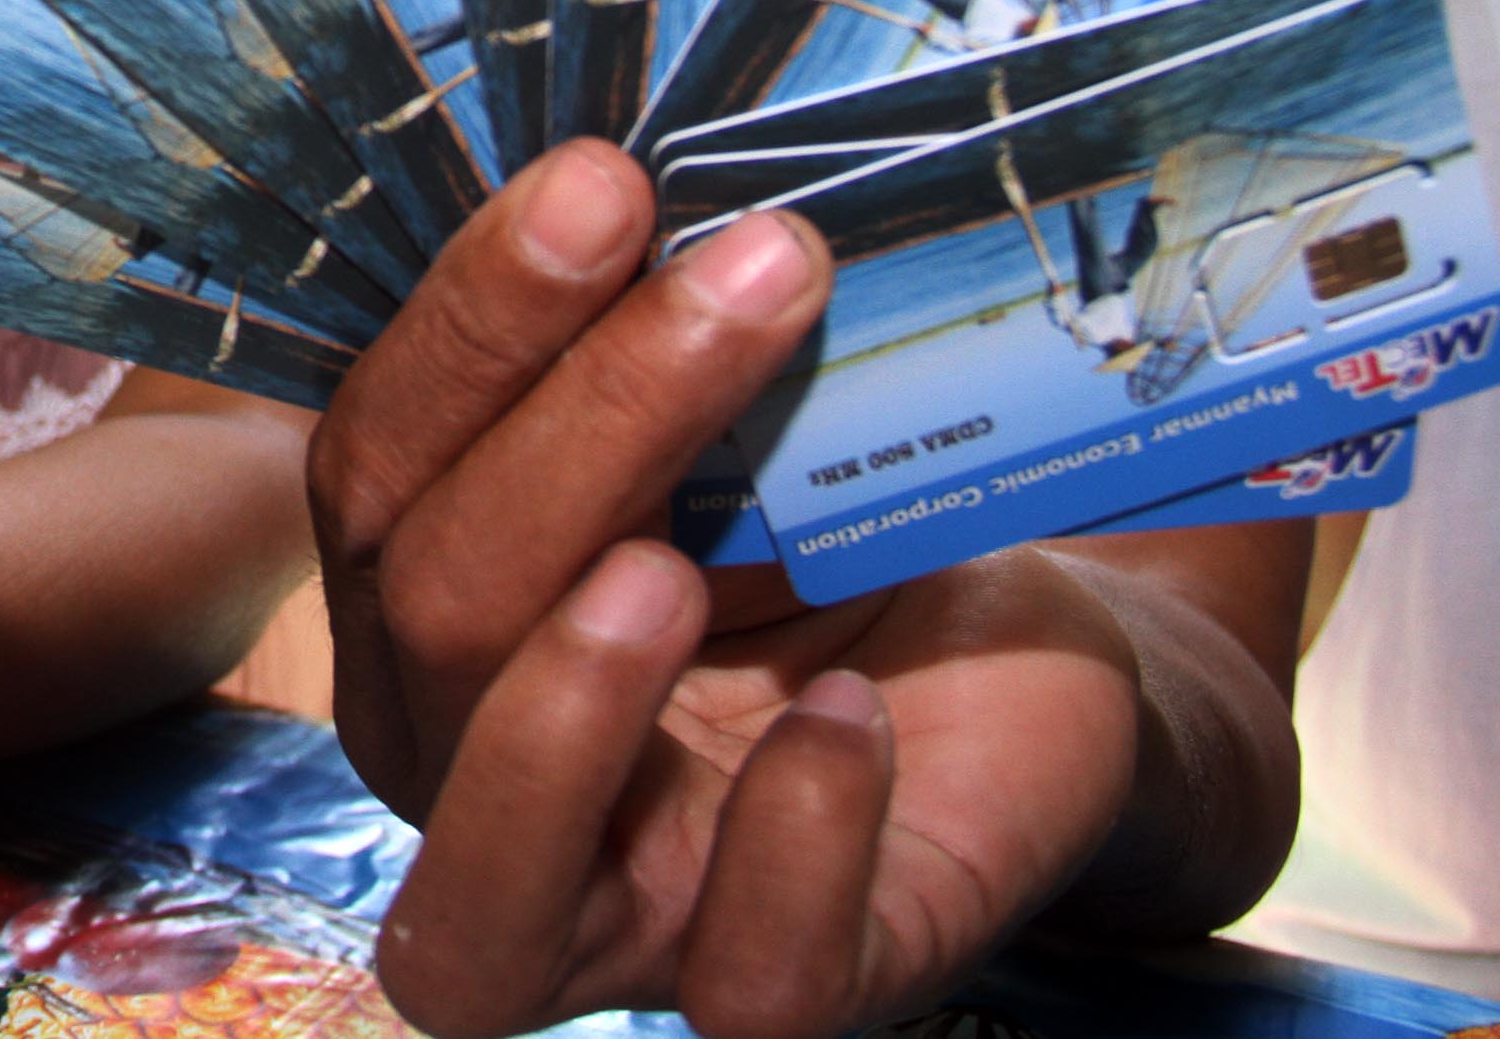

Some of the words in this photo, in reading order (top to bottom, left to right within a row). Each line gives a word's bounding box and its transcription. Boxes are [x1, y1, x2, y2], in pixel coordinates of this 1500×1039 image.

[918, 414, 994, 452] CDMA
[1151, 380, 1298, 442] Myanmar
[988, 432, 1143, 495] Economic
[796, 483, 985, 556] Corporation
